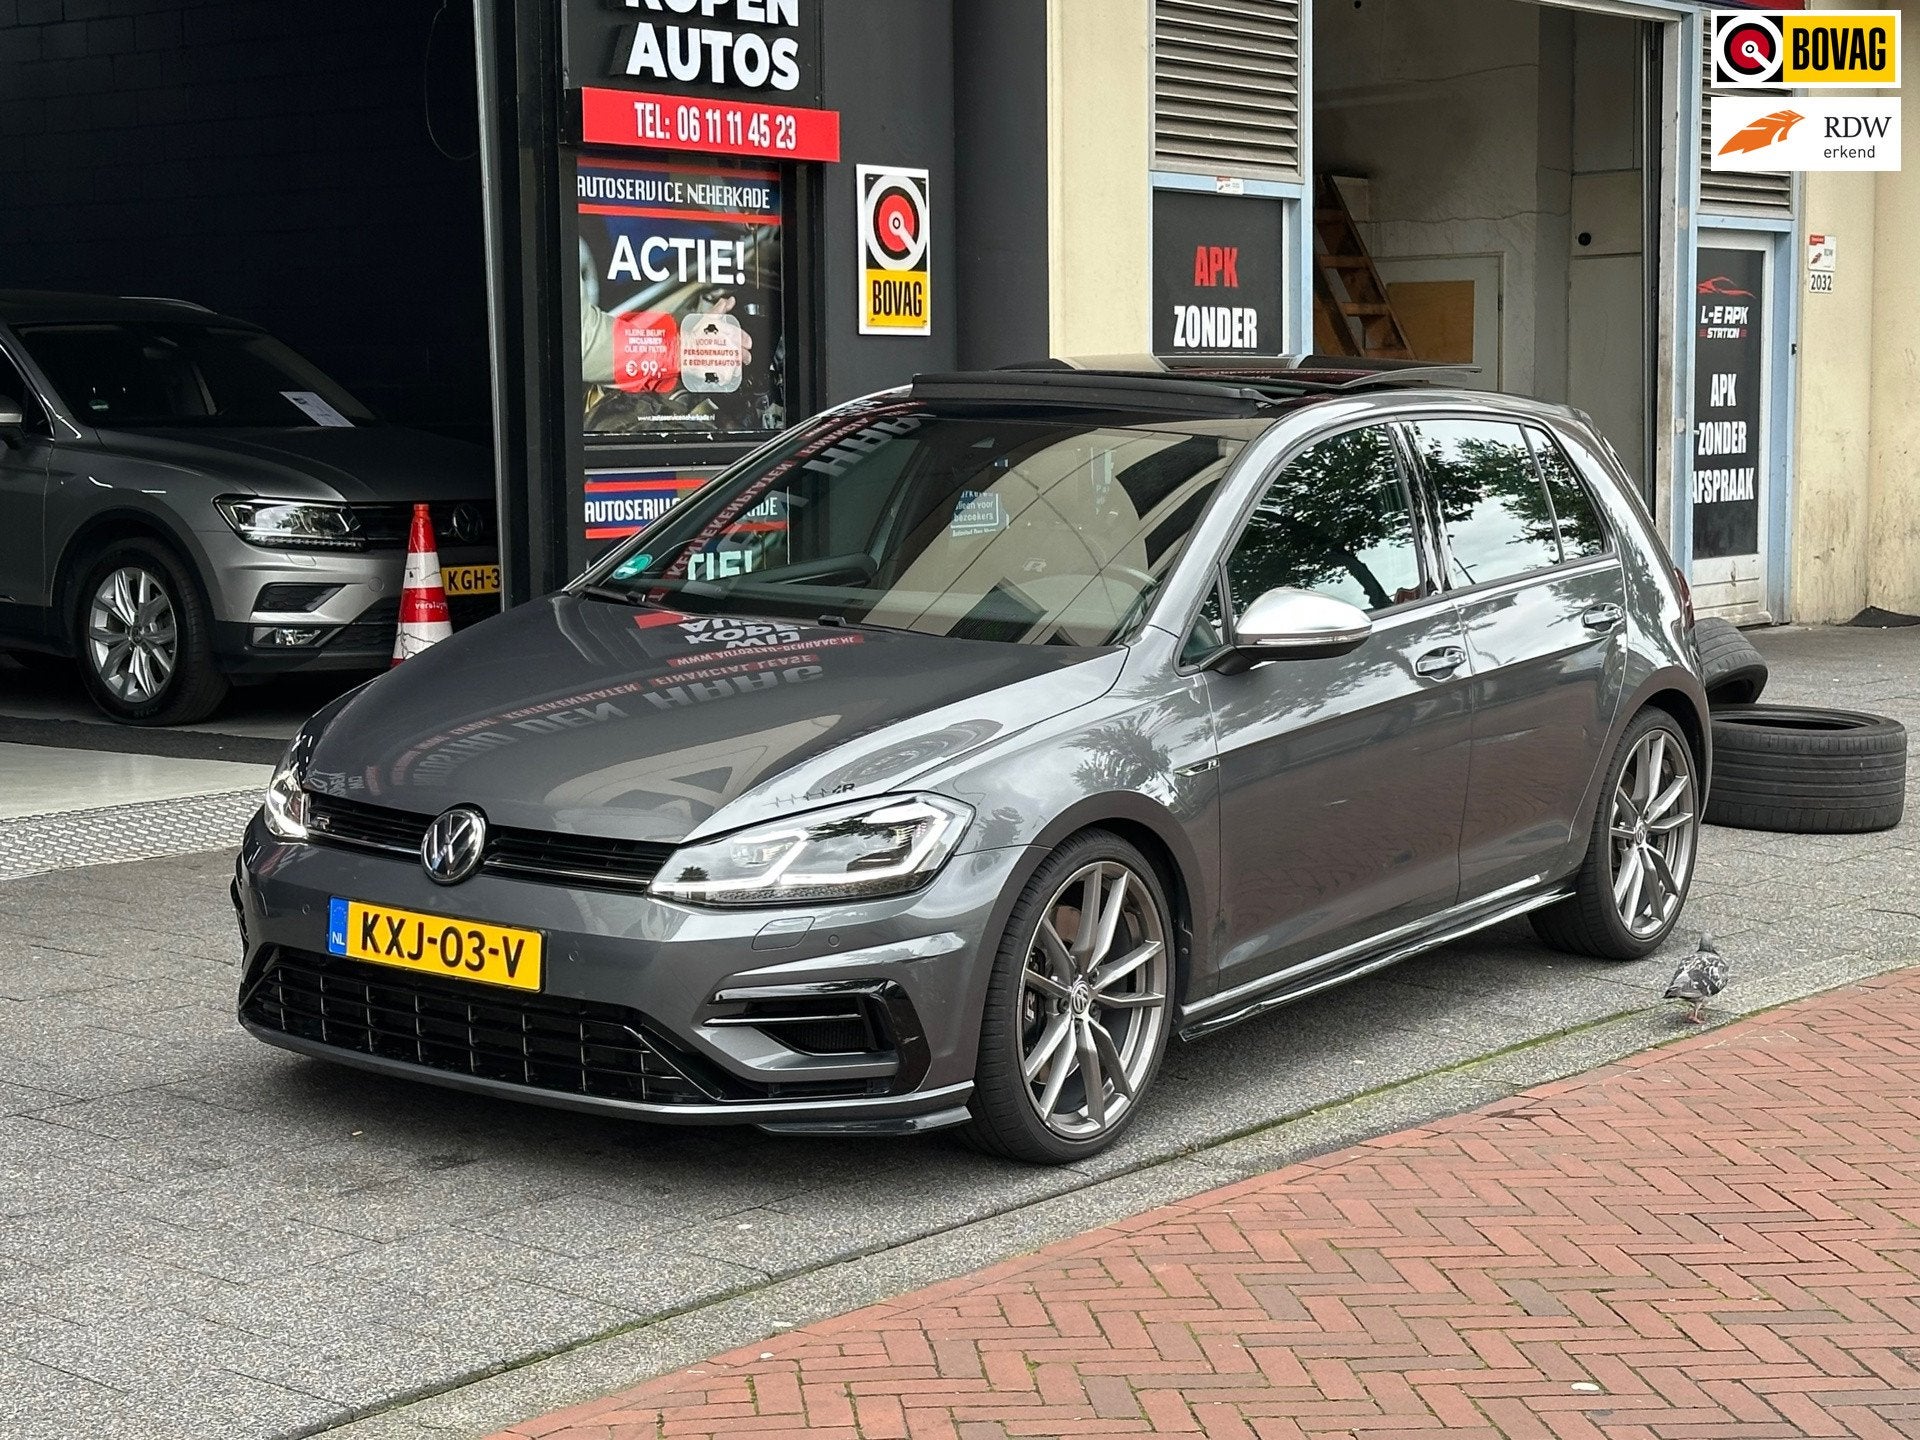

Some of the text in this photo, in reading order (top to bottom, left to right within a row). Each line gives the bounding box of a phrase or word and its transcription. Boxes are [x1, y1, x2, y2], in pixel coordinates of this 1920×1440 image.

[625, 21, 800, 91] AUTOS
[633, 101, 797, 151] TEL: 06 11 11 45 23
[576, 174, 771, 209] AUTOSERVICE NEHERKADE
[606, 234, 747, 286] ACTIE!
[1193, 244, 1240, 288] APK
[871, 278, 923, 318] BOVAG
[1810, 274, 1832, 291] 2032
[1172, 304, 1258, 349] ZONDER
[1700, 305, 1749, 325] L-E APK
[1706, 327, 1740, 339] STATION
[1710, 373, 1737, 407] APK
[1698, 421, 1747, 456] ZONDER
[331, 931, 346, 947] NL
[360, 911, 526, 979] KXJ-03-V
